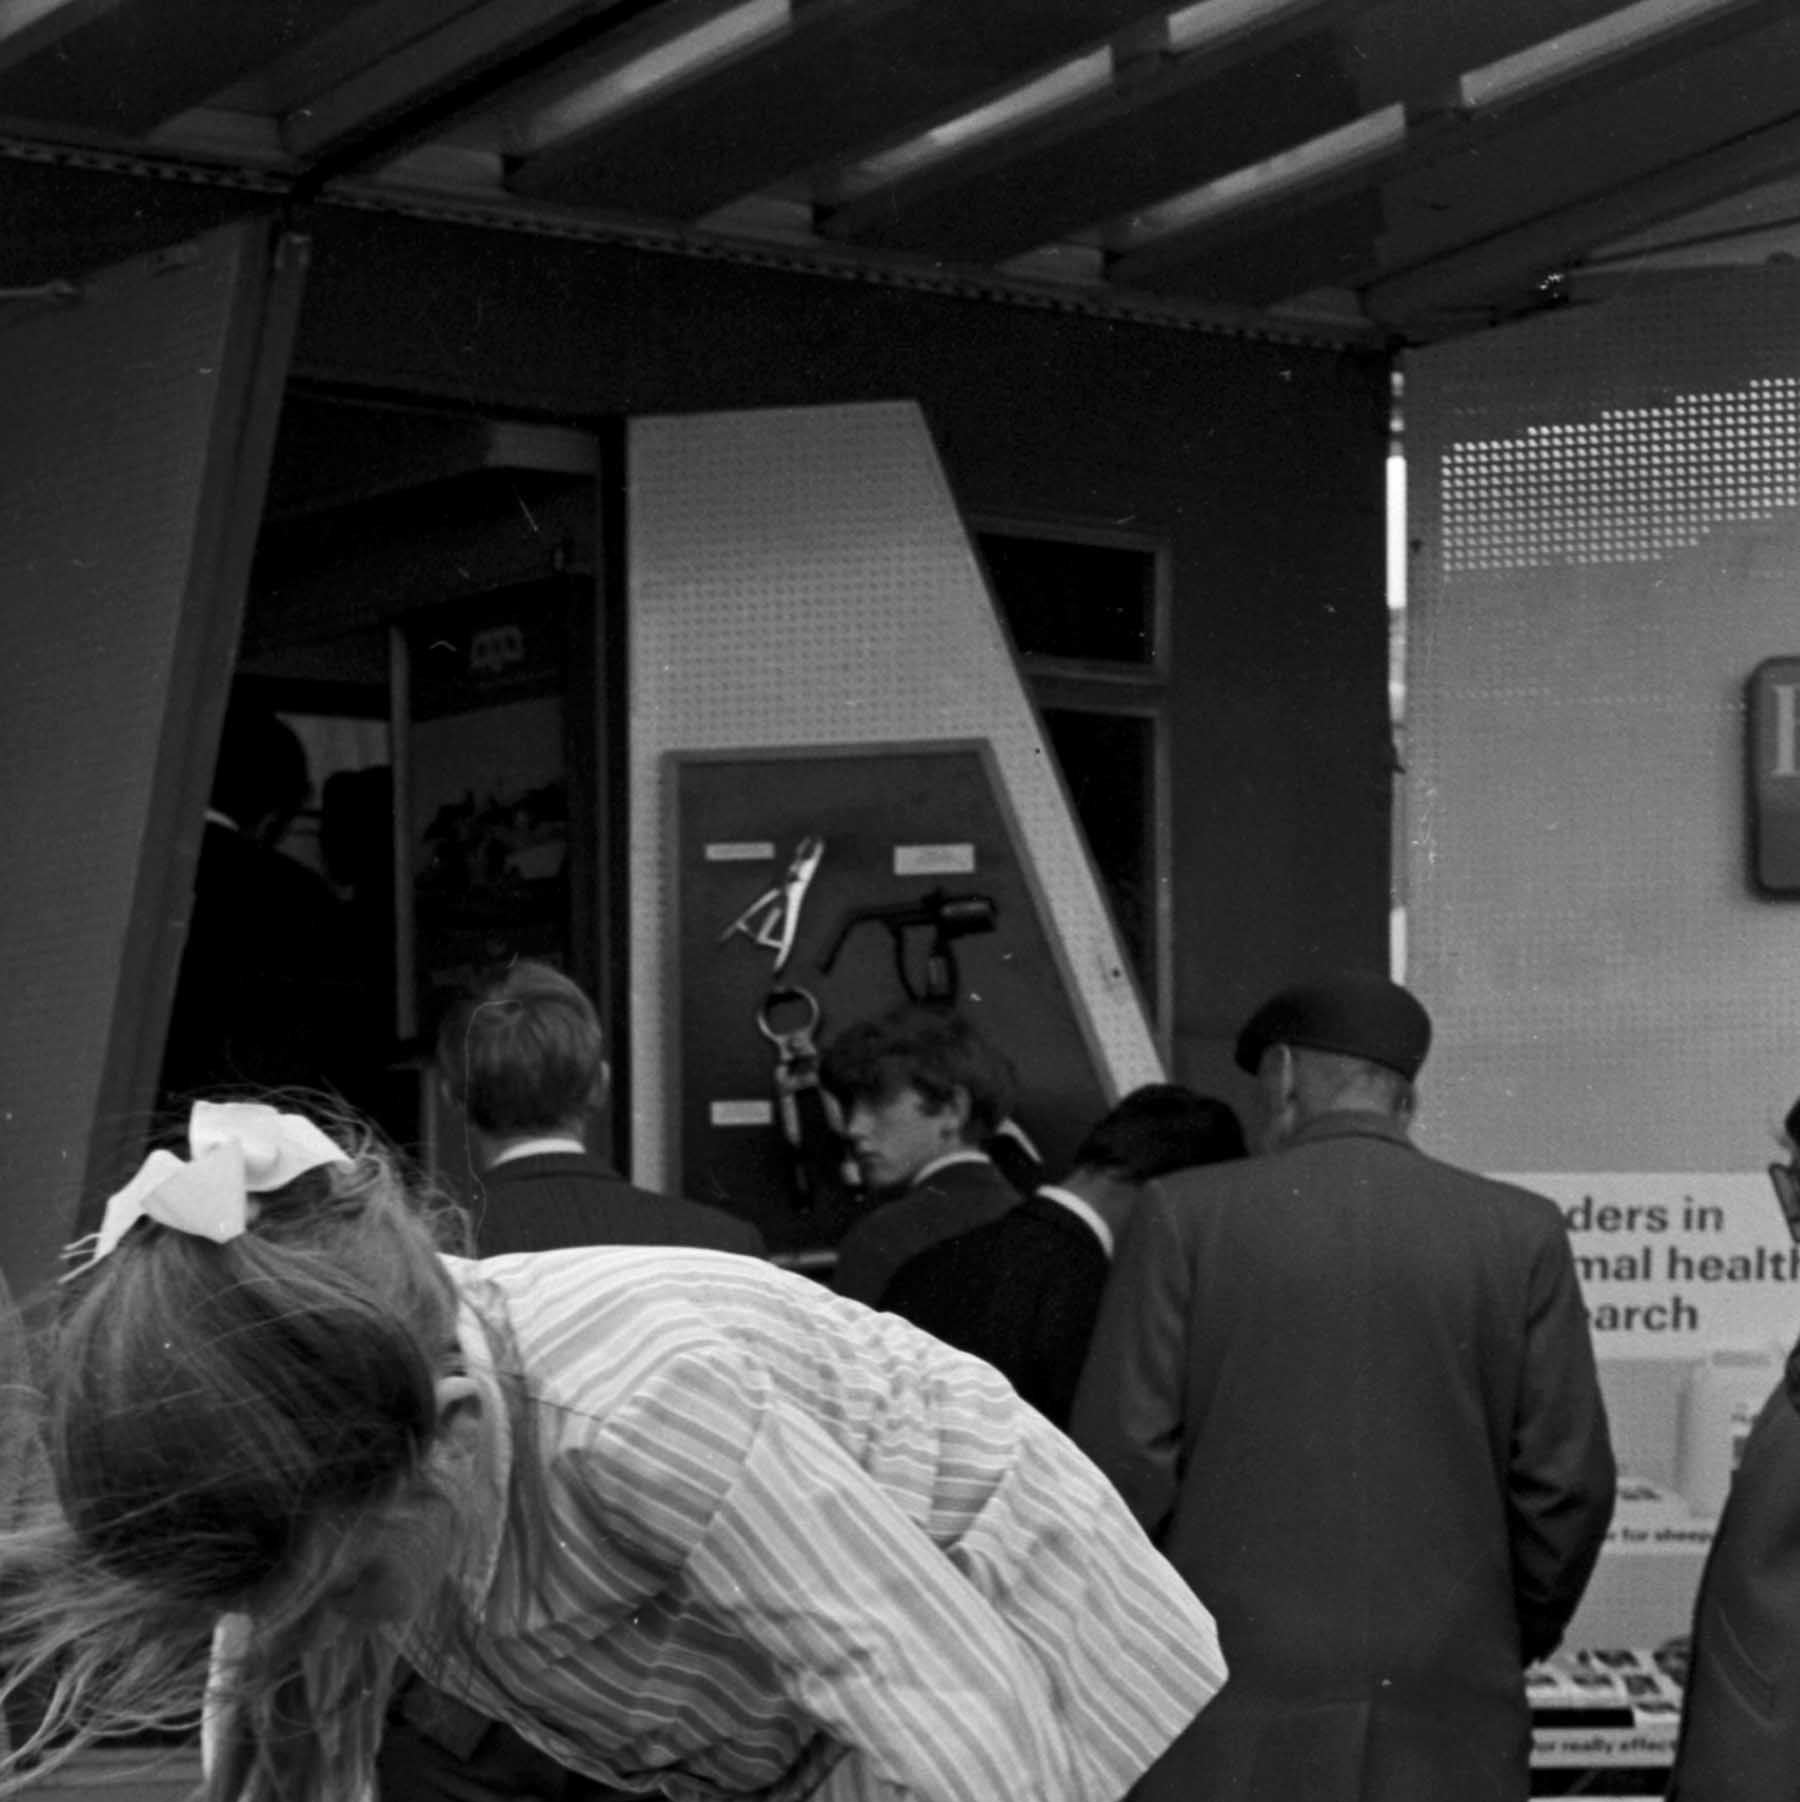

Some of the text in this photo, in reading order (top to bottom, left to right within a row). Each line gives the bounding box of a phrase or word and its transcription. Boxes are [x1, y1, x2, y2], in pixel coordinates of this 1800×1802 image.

[1566, 1195, 1725, 1232] ders in
[1573, 1245, 1651, 1281] mal
[1594, 1294, 1698, 1331] arch
